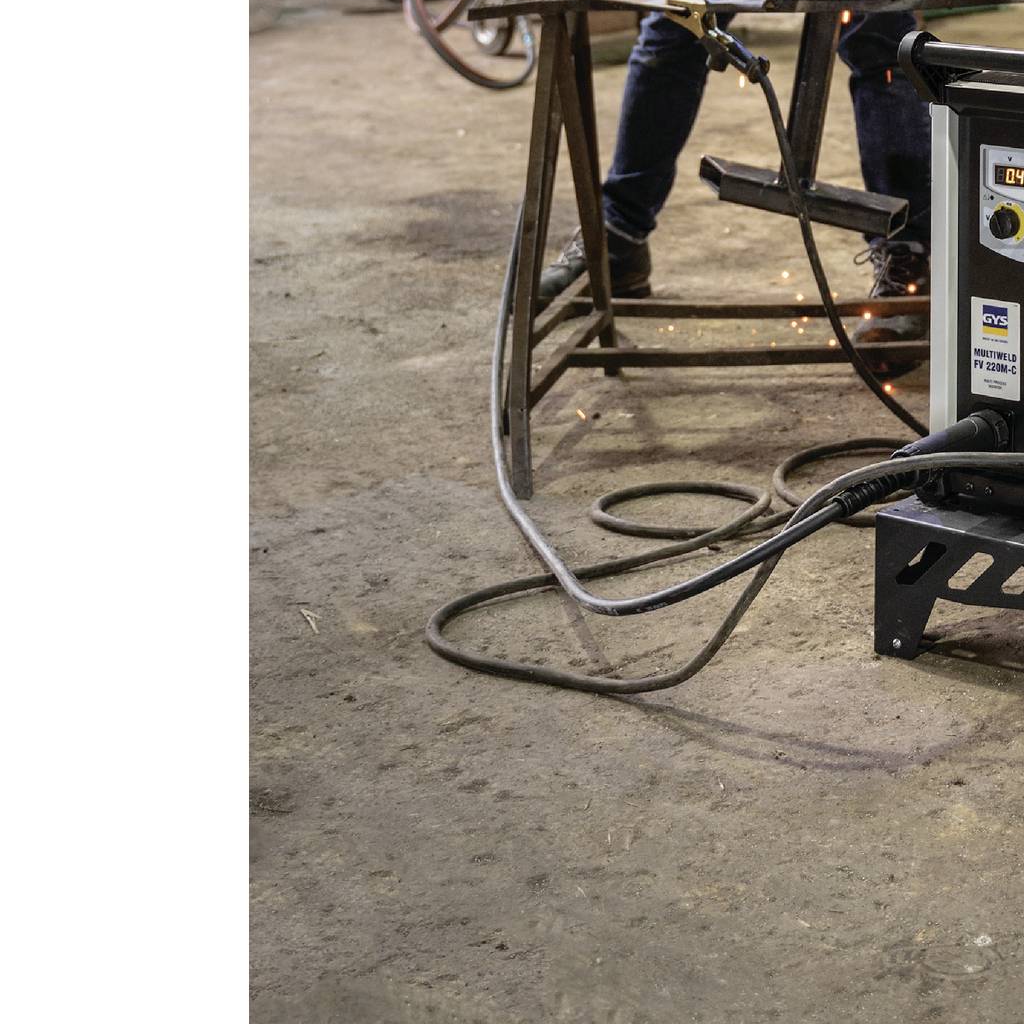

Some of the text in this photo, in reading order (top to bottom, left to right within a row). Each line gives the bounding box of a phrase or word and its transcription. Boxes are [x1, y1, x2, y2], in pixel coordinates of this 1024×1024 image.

[983, 313, 1008, 326] GYS
[974, 347, 1017, 363] MULTIWELD
[974, 359, 1017, 375] FV 220M-C
